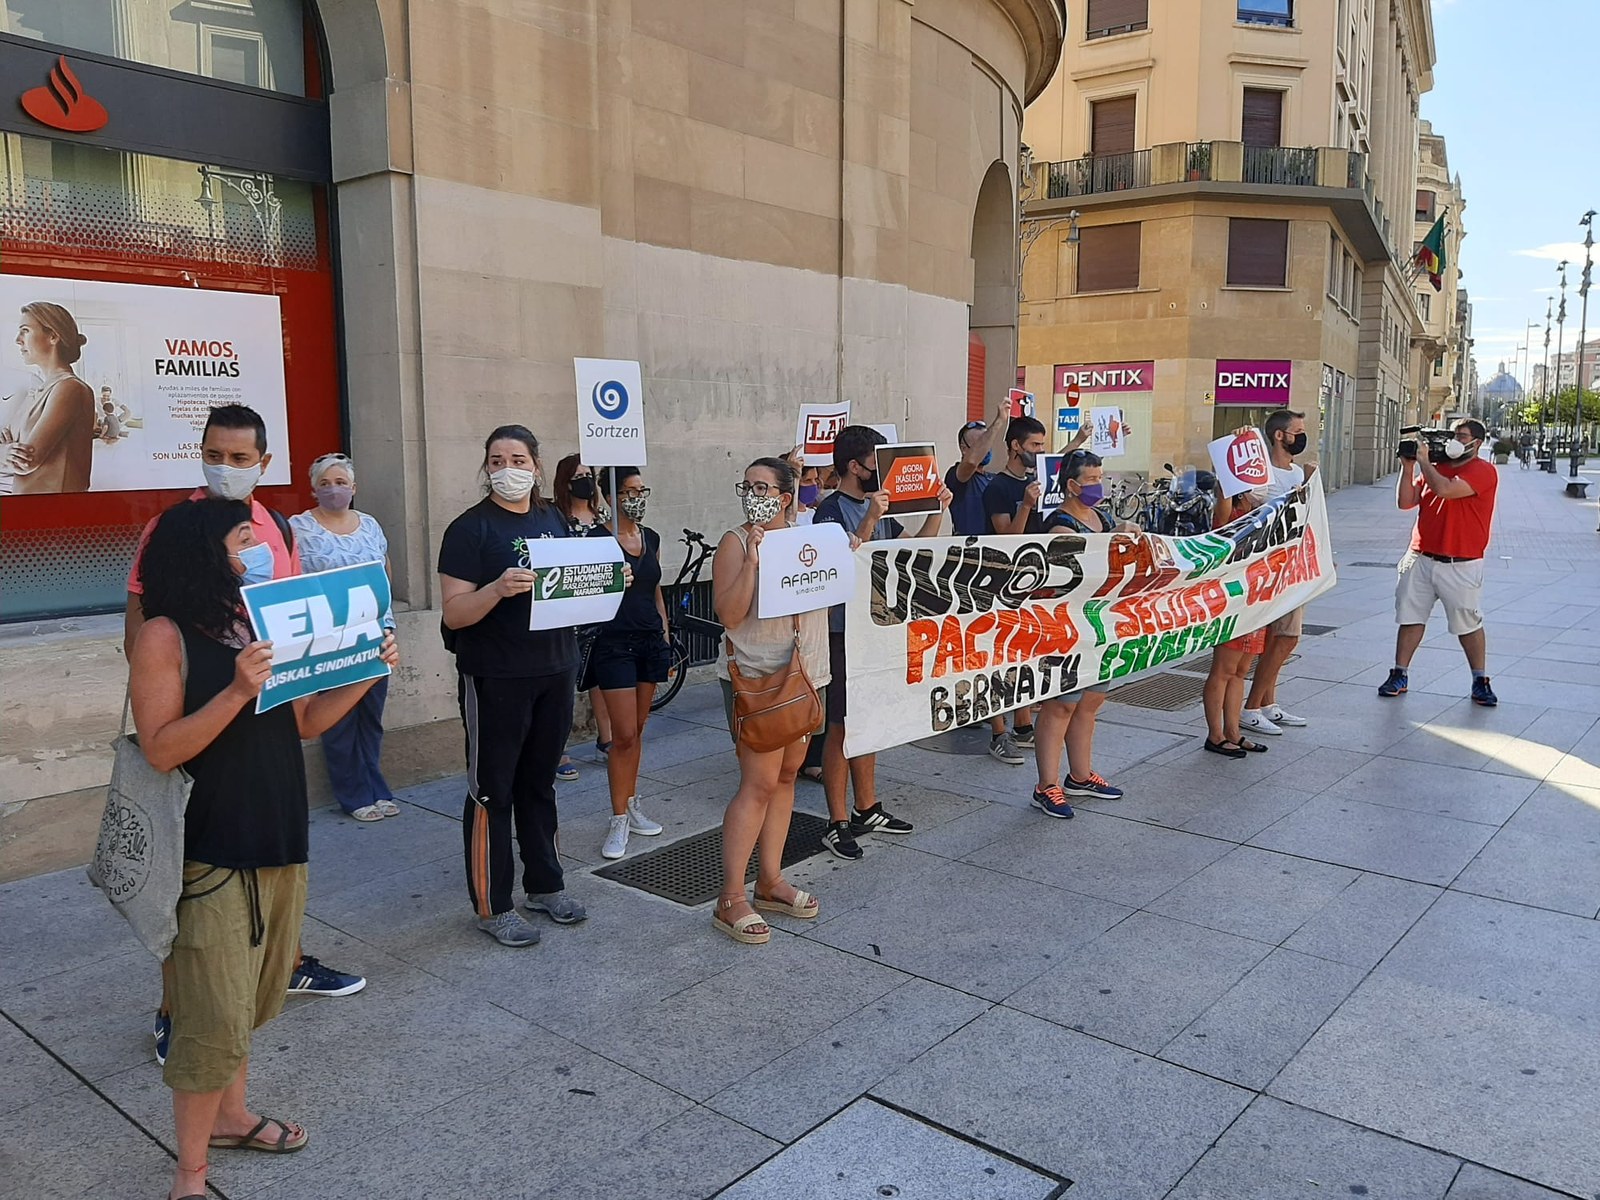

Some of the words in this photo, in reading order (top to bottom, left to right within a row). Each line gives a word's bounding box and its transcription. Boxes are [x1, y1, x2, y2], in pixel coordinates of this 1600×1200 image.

[165, 339, 238, 360] VAMOS,
[155, 359, 240, 378] FAMILIAS
[1063, 369, 1142, 387] DENTIX
[1218, 372, 1288, 388] DENTIX
[1058, 416, 1079, 424] TAXI
[586, 422, 638, 438] Sortzen
[896, 483, 924, 494] BORROKA
[562, 575, 572, 584] EN
[573, 572, 614, 583] MOVIMIENTO
[564, 564, 614, 576] ESTUDIANTES
[781, 568, 838, 589] AFAPNA
[574, 587, 604, 596] NAFARROA
[795, 585, 826, 596] sindicato
[1109, 579, 1227, 639] SEGURO
[260, 584, 383, 666] ELA
[264, 667, 312, 691] EUSKAL
[314, 646, 380, 676] SINDIKATUA
[930, 653, 1082, 732] BERMATU
